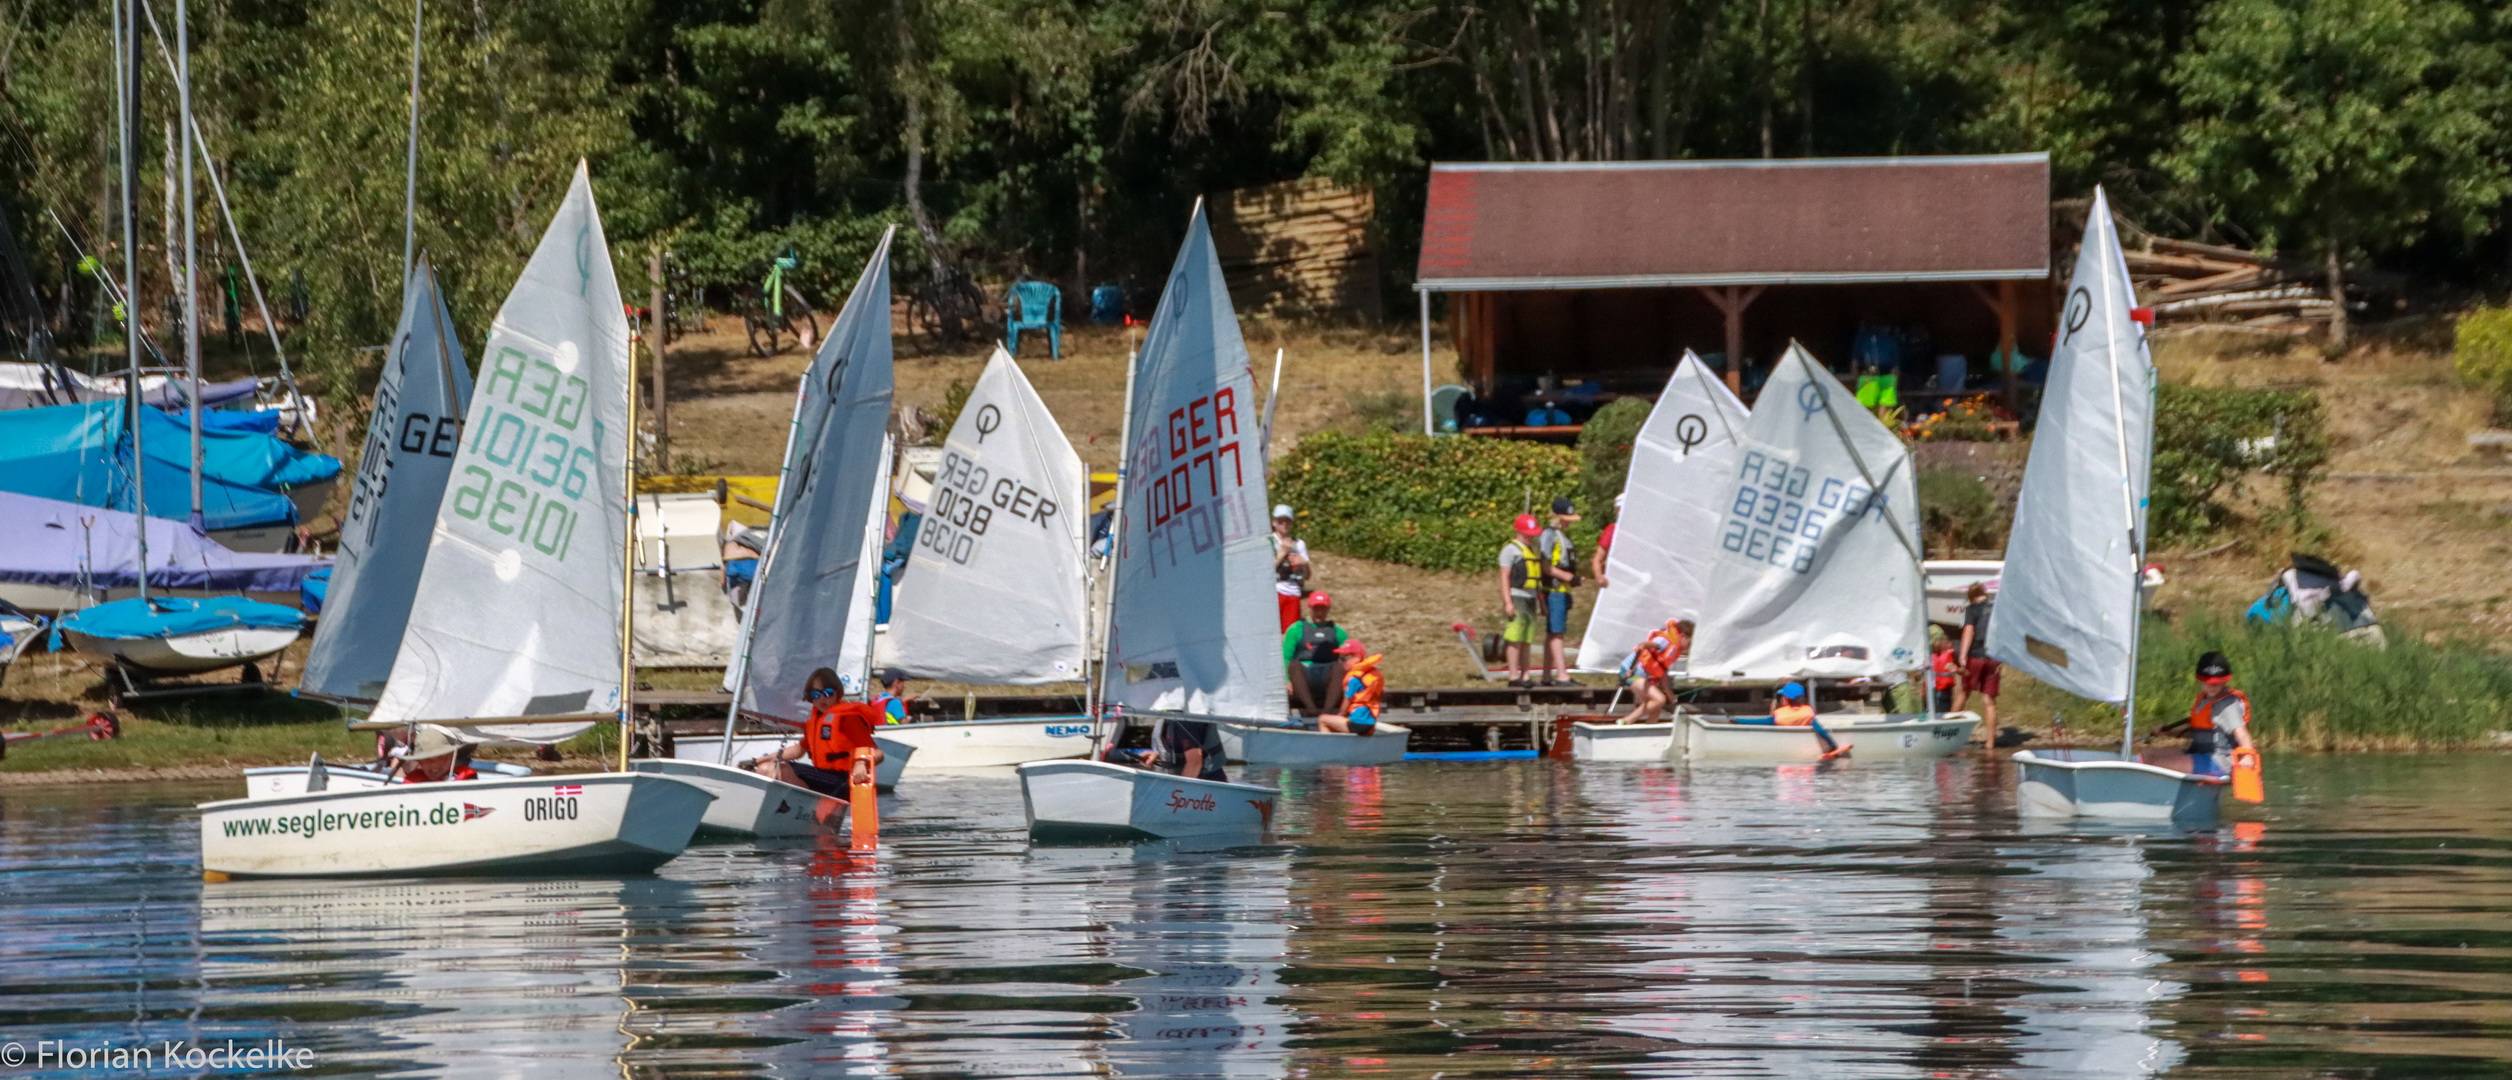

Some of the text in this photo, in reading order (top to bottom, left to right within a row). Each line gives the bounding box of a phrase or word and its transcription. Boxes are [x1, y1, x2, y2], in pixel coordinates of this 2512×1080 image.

[400, 412, 464, 458] GE
[1169, 387, 1238, 461] GER
[469, 405, 594, 500] 10136
[991, 478, 1057, 530] GER
[1146, 441, 1242, 532] 10077
[1733, 485, 1826, 541] 8336
[1045, 725, 1090, 736] NEMO
[223, 801, 460, 839] www.seglerverein.de
[524, 796, 578, 822] ORIGO
[1166, 789, 1216, 814] Sprotte
